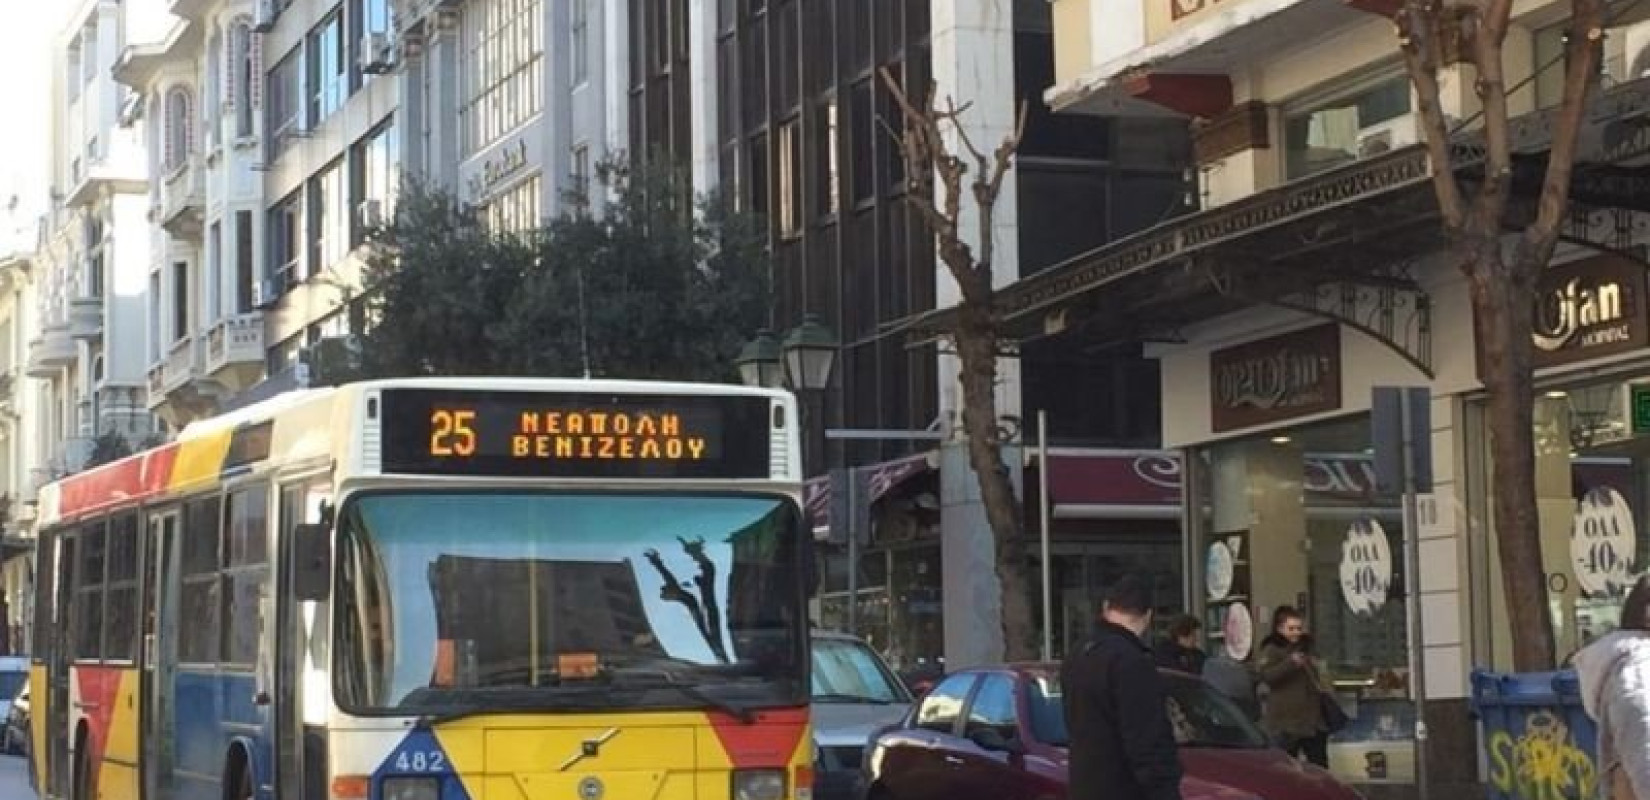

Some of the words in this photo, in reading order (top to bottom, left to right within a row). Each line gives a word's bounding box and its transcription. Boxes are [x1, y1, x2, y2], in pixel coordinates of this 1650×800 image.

[430, 410, 476, 457] 25
[520, 411, 680, 435] ΝΕΑΠΟΛΗ
[511, 434, 705, 459] ΒΕΝΙΖΕΛΟΥ
[395, 750, 444, 772] 482
